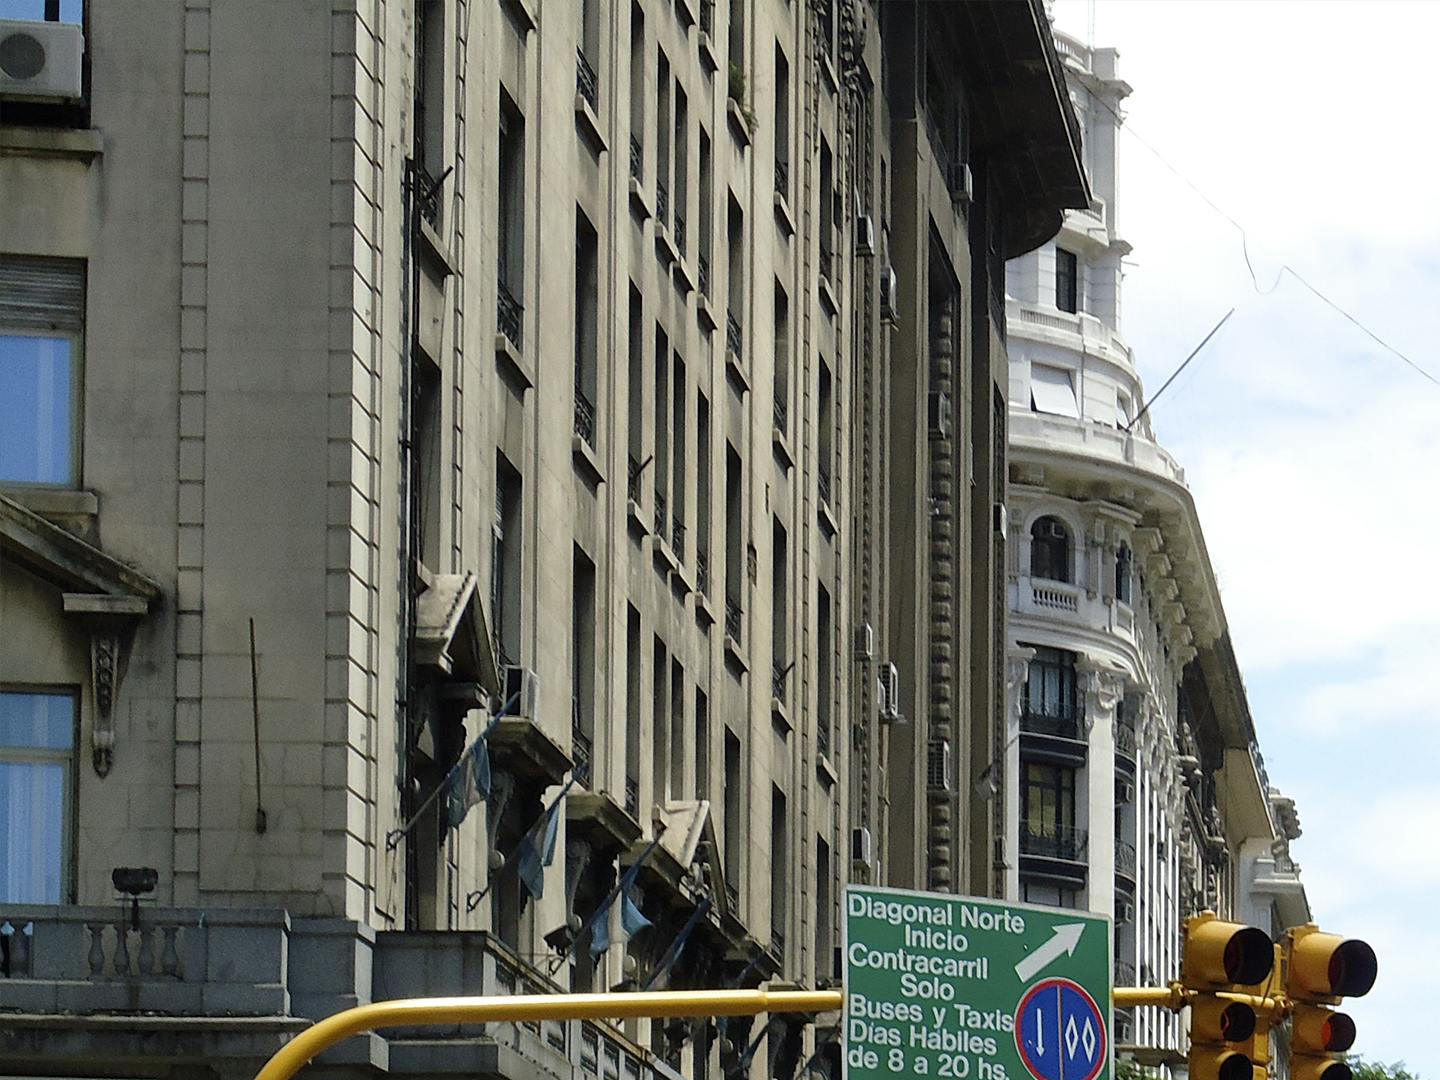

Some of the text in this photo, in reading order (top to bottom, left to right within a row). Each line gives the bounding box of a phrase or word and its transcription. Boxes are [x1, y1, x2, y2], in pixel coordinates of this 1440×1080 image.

[849, 894, 1025, 934] Diagonal Norte
[904, 924, 969, 952] Inicio
[848, 943, 988, 981] Contracarril
[900, 973, 955, 1002] Solo
[850, 994, 1014, 1033] Buses y Taxis
[848, 1047, 879, 1070] de
[888, 1049, 904, 1072] 8
[914, 1057, 929, 1075] a
[937, 1054, 969, 1078] 20
